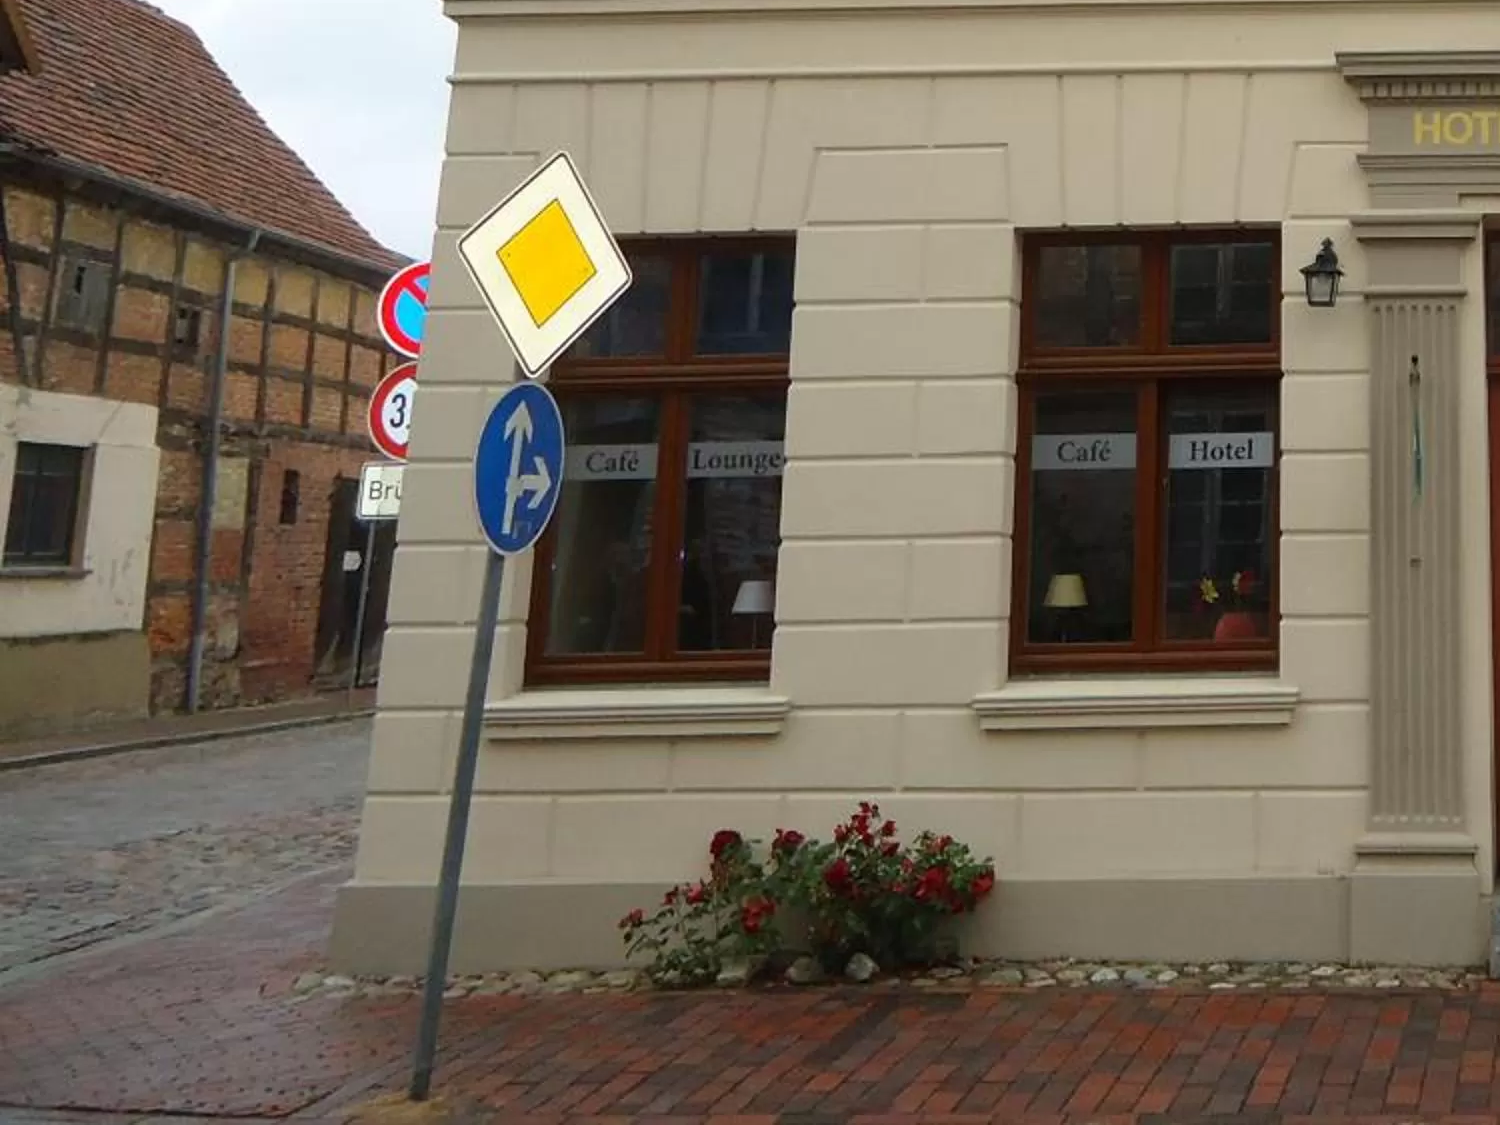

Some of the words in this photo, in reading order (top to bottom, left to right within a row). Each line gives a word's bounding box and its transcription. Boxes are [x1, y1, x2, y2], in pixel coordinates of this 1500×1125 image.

[585, 450, 640, 474] Café
[692, 448, 782, 475] Lounge
[1056, 440, 1112, 463] Café
[1189, 438, 1255, 461] Hotel
